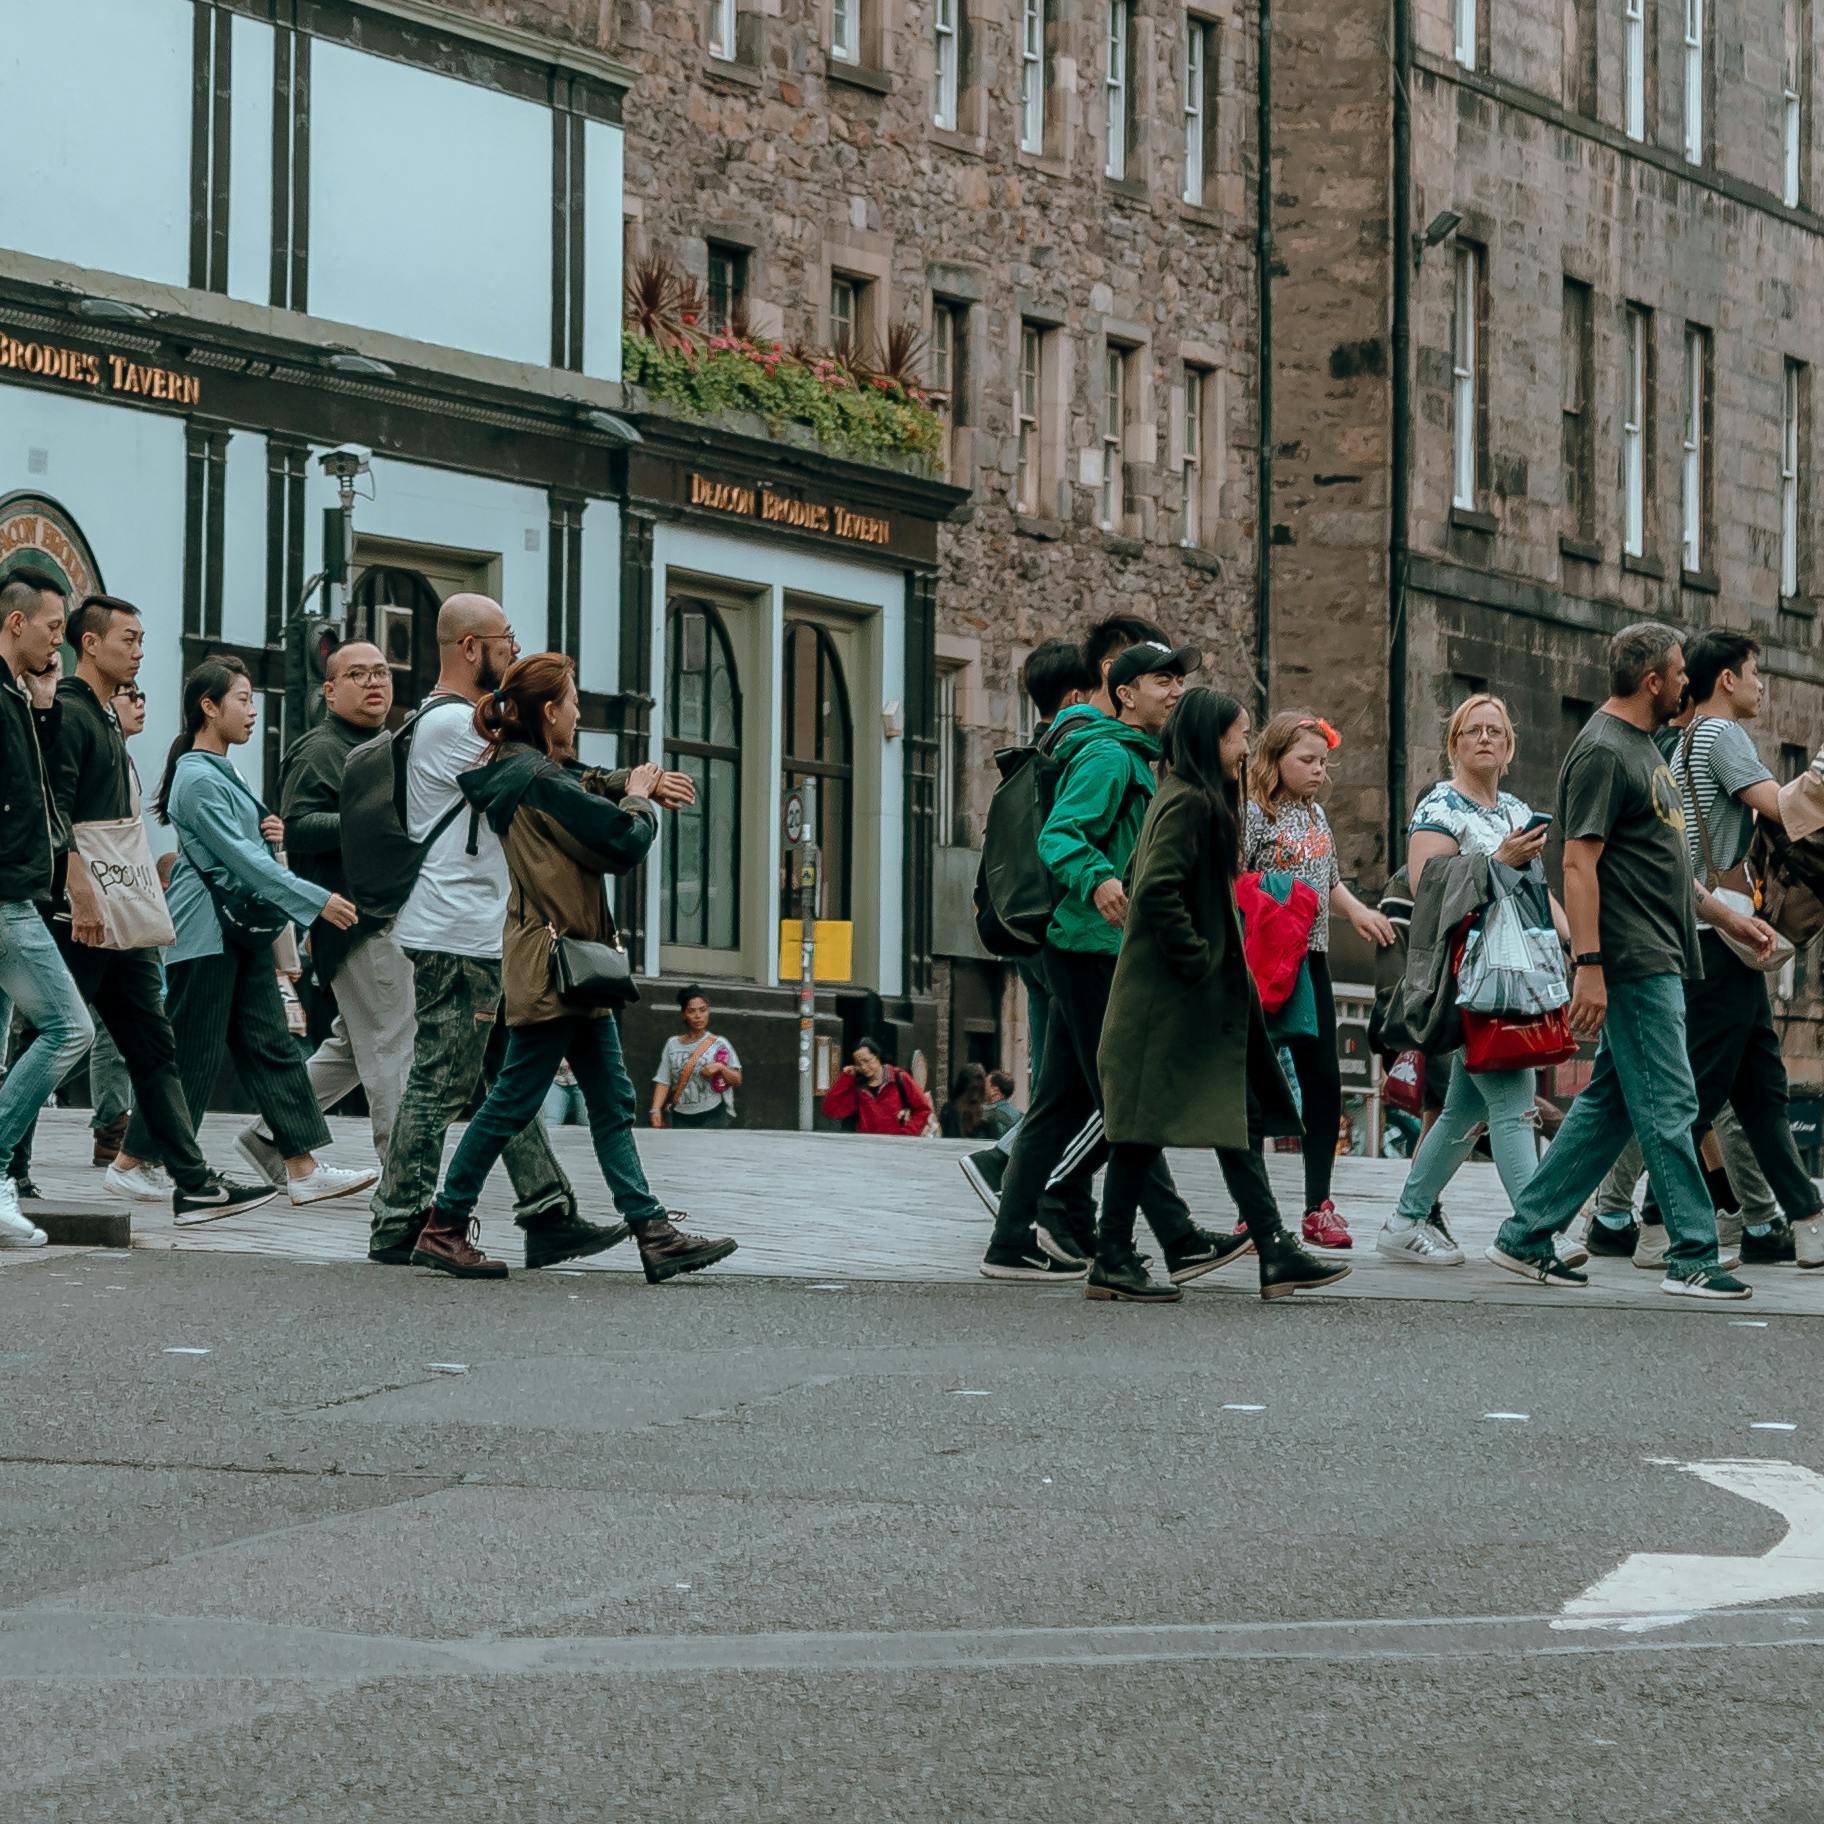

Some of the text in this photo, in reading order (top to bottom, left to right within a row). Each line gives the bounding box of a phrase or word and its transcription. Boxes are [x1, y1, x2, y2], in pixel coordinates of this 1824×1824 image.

[108, 354, 201, 405] TAVERN
[691, 472, 756, 515] DEACON
[833, 505, 890, 545] TAVERN
